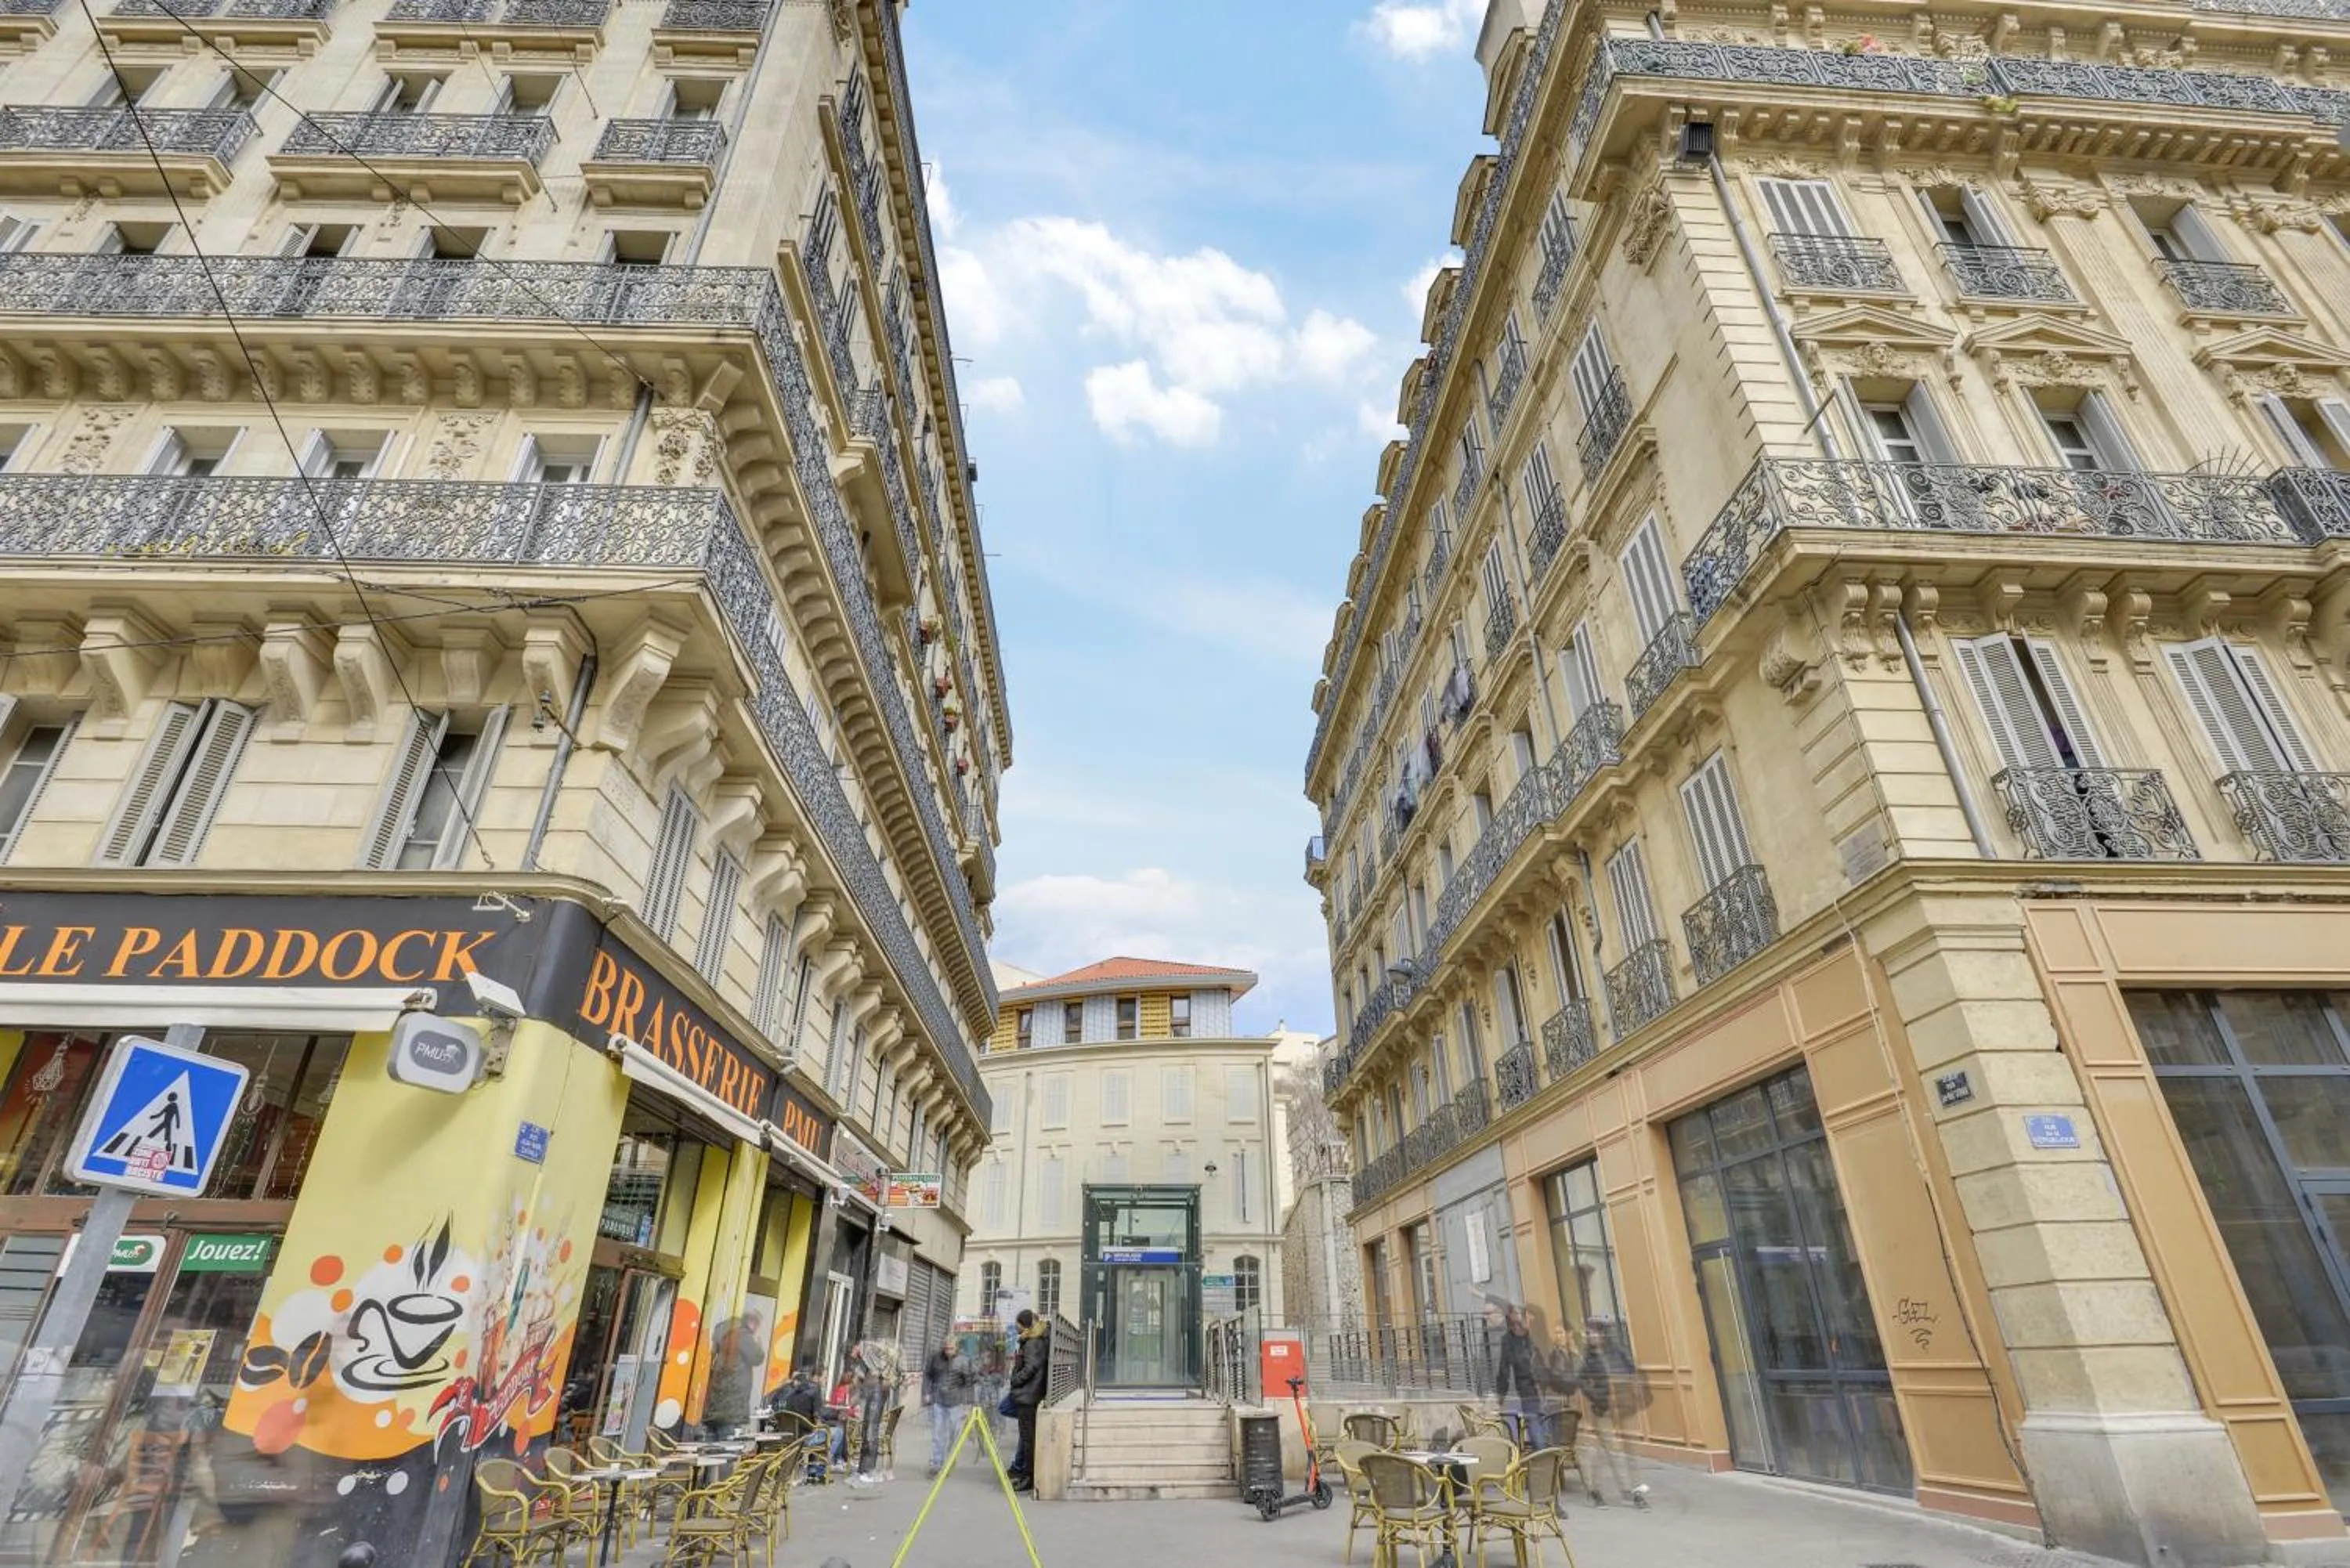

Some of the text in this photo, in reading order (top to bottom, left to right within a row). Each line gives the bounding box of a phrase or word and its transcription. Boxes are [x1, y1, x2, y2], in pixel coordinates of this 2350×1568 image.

[0, 925, 497, 982] LE PADDOCK
[415, 1042, 446, 1061] PMU
[577, 948, 825, 1155] BRASSERIE PMU
[188, 1240, 266, 1261] Jouez!
